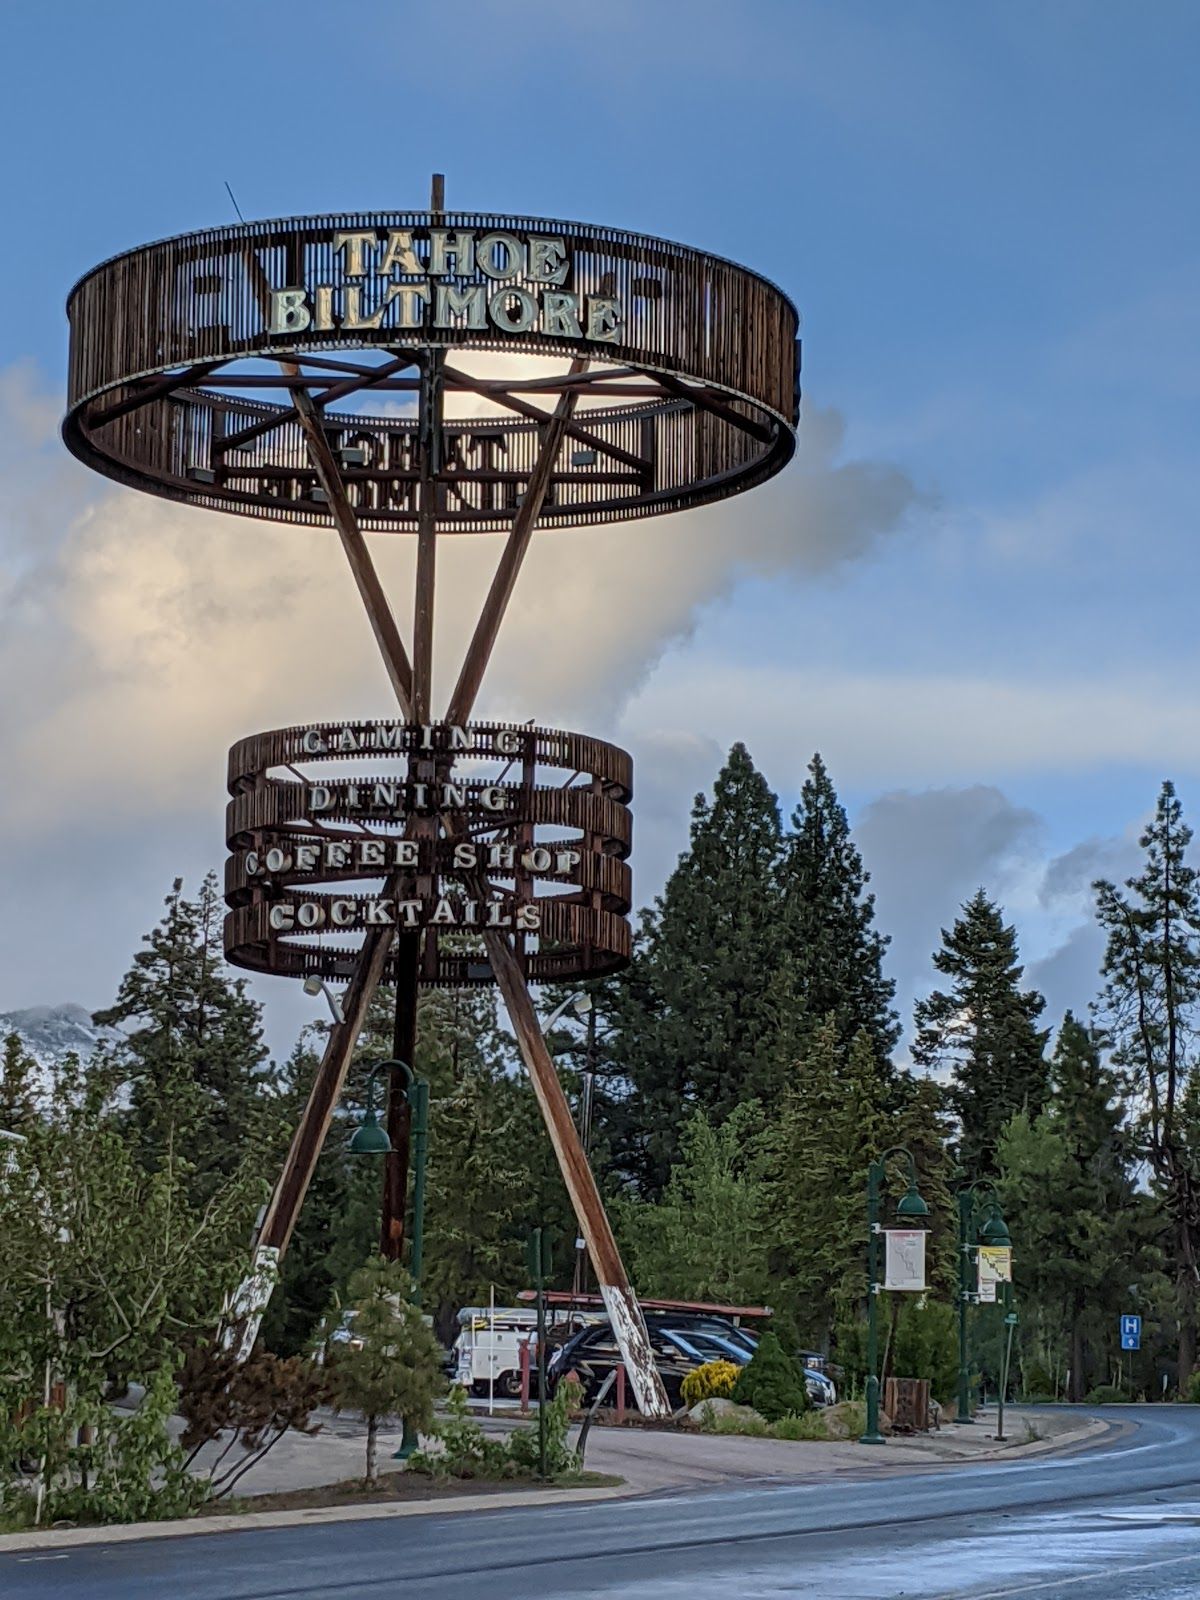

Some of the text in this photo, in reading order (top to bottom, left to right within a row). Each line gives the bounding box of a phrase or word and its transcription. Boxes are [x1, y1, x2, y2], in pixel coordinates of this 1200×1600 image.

[333, 228, 570, 285] TAHOE
[267, 282, 624, 345] BILTMORE
[303, 723, 522, 754] GAMING
[308, 782, 509, 812] DINING
[245, 840, 581, 877] COFFEE SHOP
[269, 899, 541, 931] COCKTAILS
[1125, 1318, 1138, 1334] H
